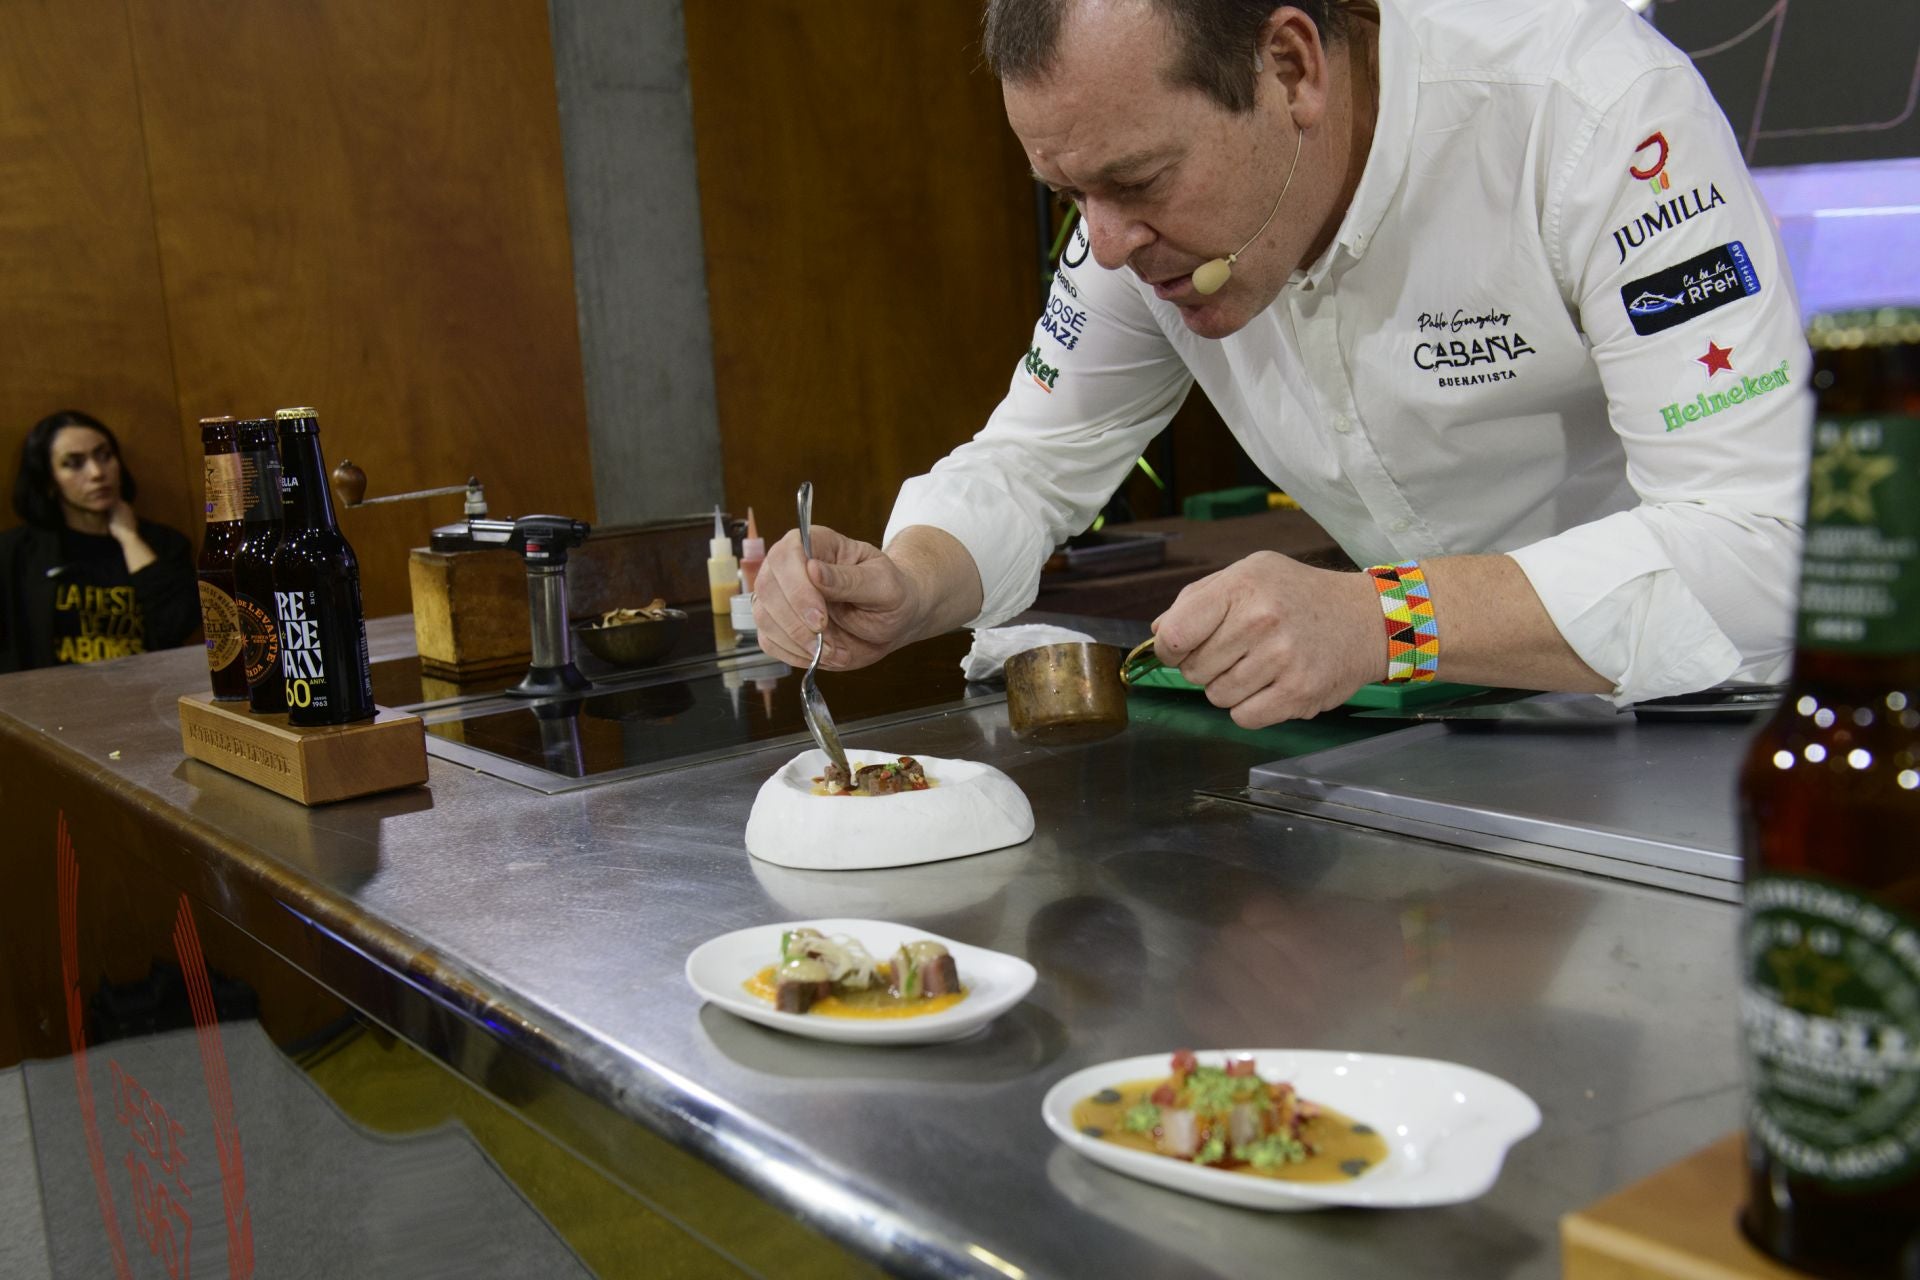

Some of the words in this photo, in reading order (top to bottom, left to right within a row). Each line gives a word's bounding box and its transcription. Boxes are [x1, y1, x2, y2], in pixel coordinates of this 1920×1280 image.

[1612, 182, 1726, 265] JUMILLA
[1687, 270, 1739, 304] RFeH
[1040, 312, 1071, 347] DÍAZ
[1047, 294, 1087, 334] JOSÉ
[1437, 369, 1518, 388] BUENAVISTA
[55, 583, 82, 611] LA
[247, 602, 279, 664] LEVANTE
[285, 679, 311, 708] 60
[312, 700, 328, 708] 1963
[109, 1057, 193, 1200] DESDE
